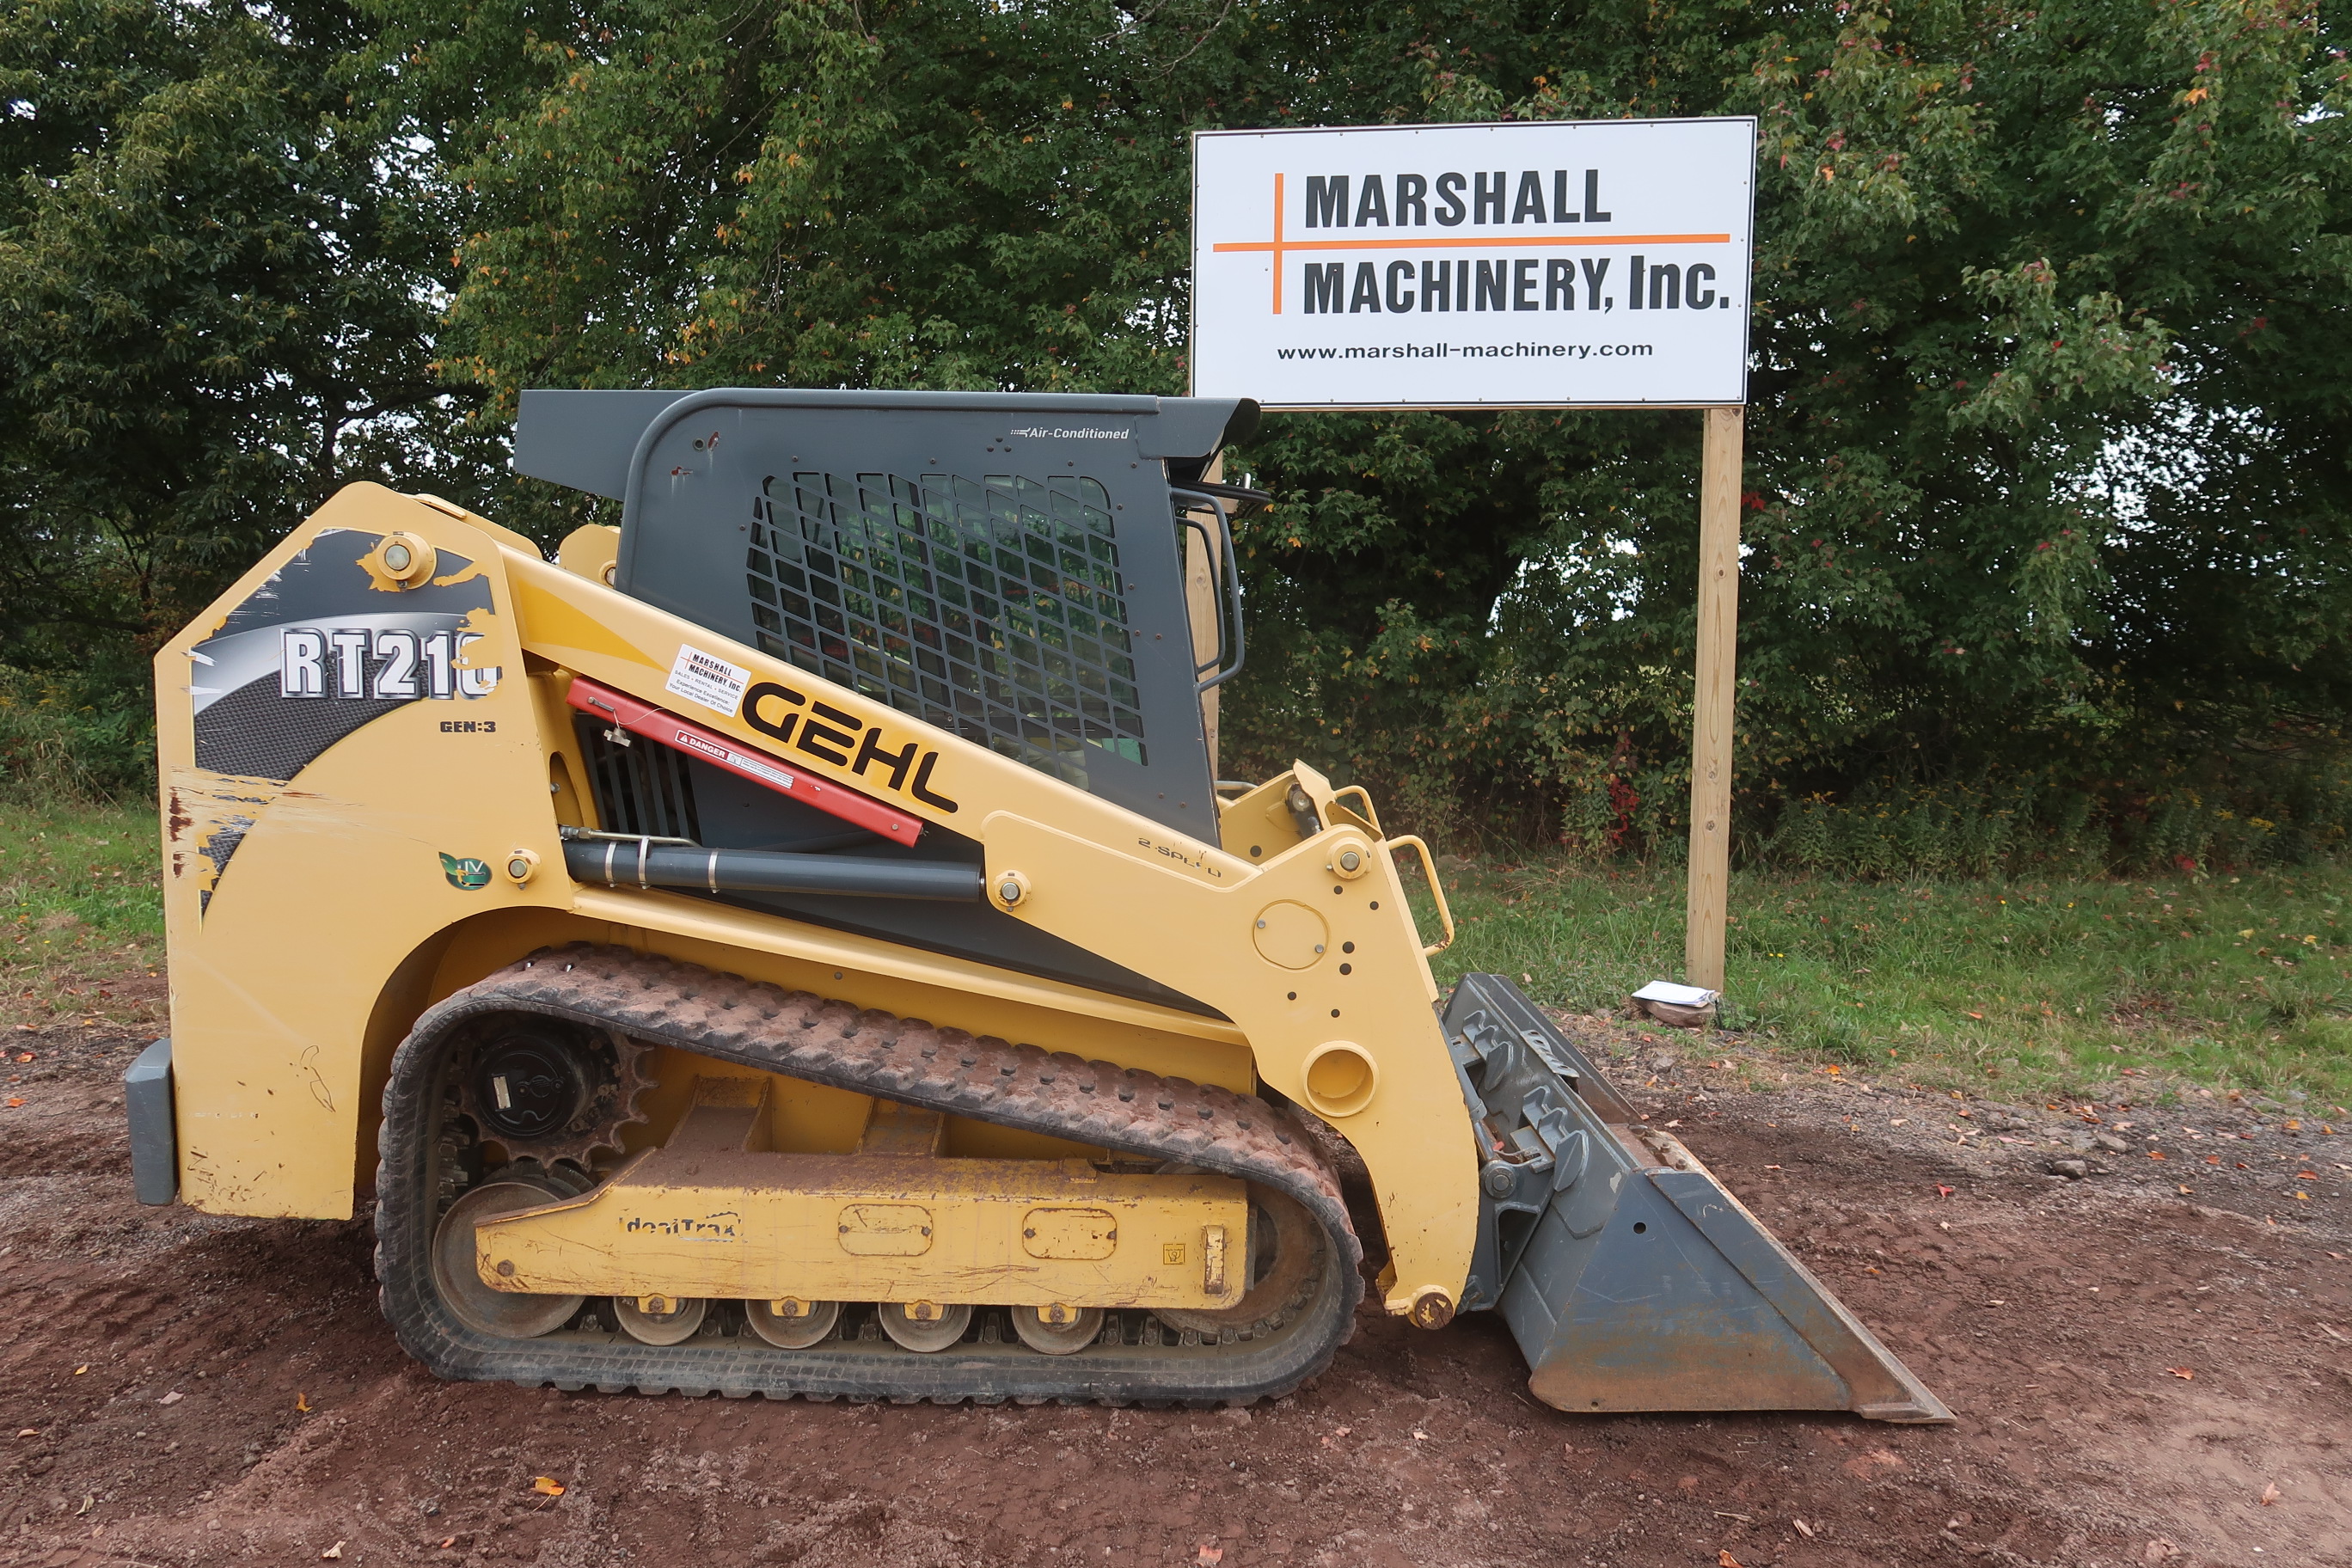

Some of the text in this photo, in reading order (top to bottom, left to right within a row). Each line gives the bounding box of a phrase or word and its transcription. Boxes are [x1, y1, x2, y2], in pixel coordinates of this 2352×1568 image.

[1305, 169, 1612, 228] MARSHALL
[1303, 255, 1730, 315] MACHINERY, Inc.
[1277, 341, 1654, 360] www.marshall-machinery.com
[1029, 427, 1130, 439] Air-Conditioned
[692, 653, 732, 677] MARSHALL
[675, 670, 738, 700] SALES RENTAL SERVICE
[676, 678, 703, 694] Experience
[689, 664, 742, 693] MACHINERY, Inc.
[670, 683, 681, 691] Your
[680, 687, 695, 696] Local
[694, 693, 709, 703] Dealer
[716, 702, 733, 714] Choice
[439, 720, 497, 733] GEN:3
[689, 738, 726, 758] DANGER
[742, 682, 959, 814] GEHL
